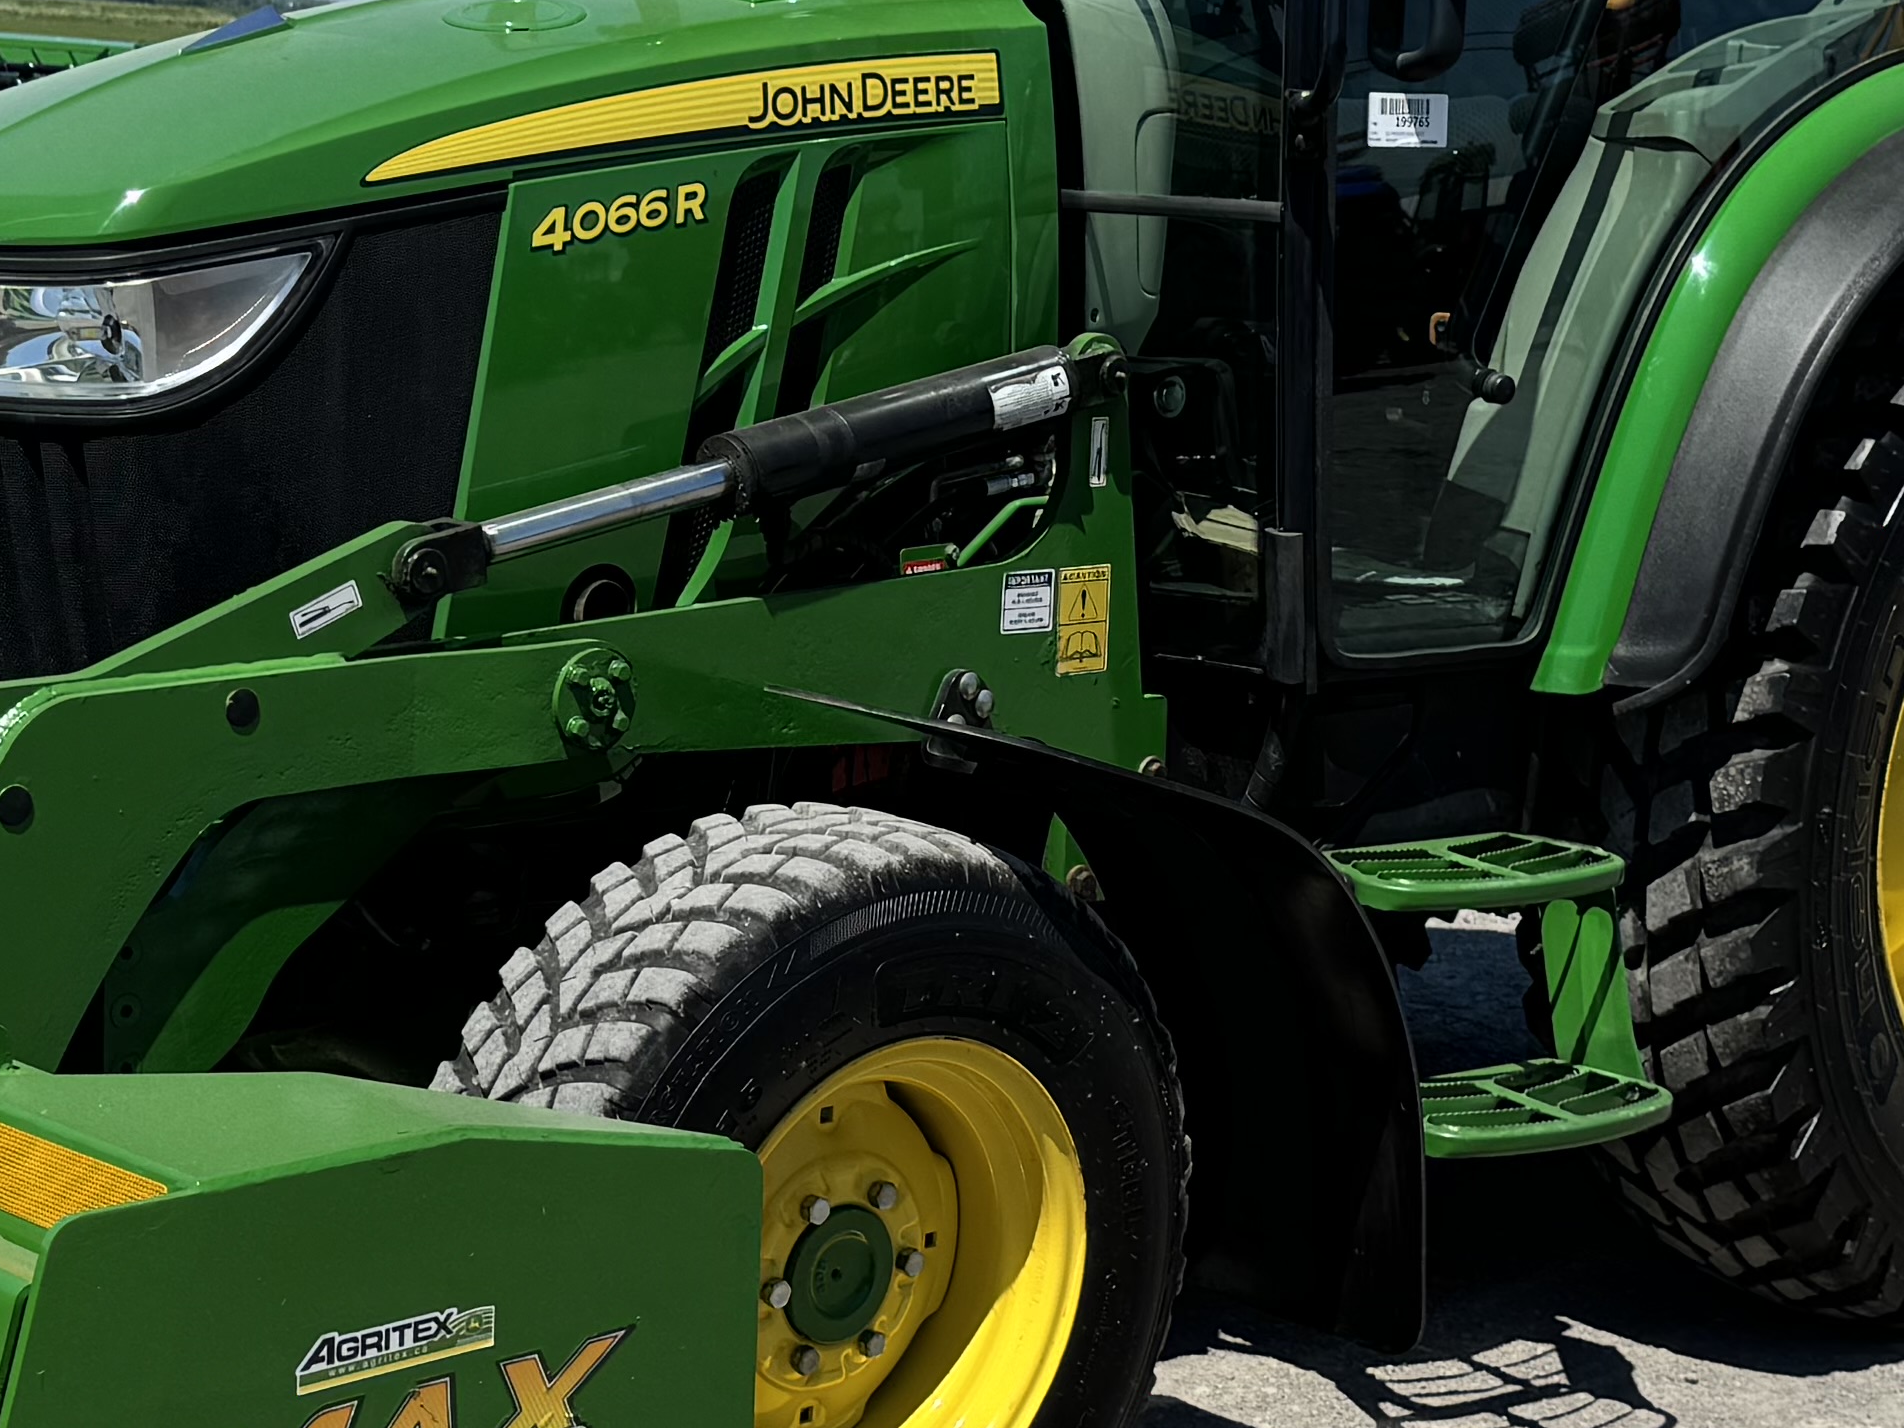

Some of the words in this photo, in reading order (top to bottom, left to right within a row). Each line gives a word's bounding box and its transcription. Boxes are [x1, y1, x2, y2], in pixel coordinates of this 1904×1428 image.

[748, 80, 853, 127] JOHN
[860, 72, 977, 114] DEERE
[1396, 116, 1430, 128] 199765
[530, 182, 707, 252] 4066R
[300, 1311, 455, 1372] AGRITEX
[327, 1344, 428, 1378] www.agritex.ca
